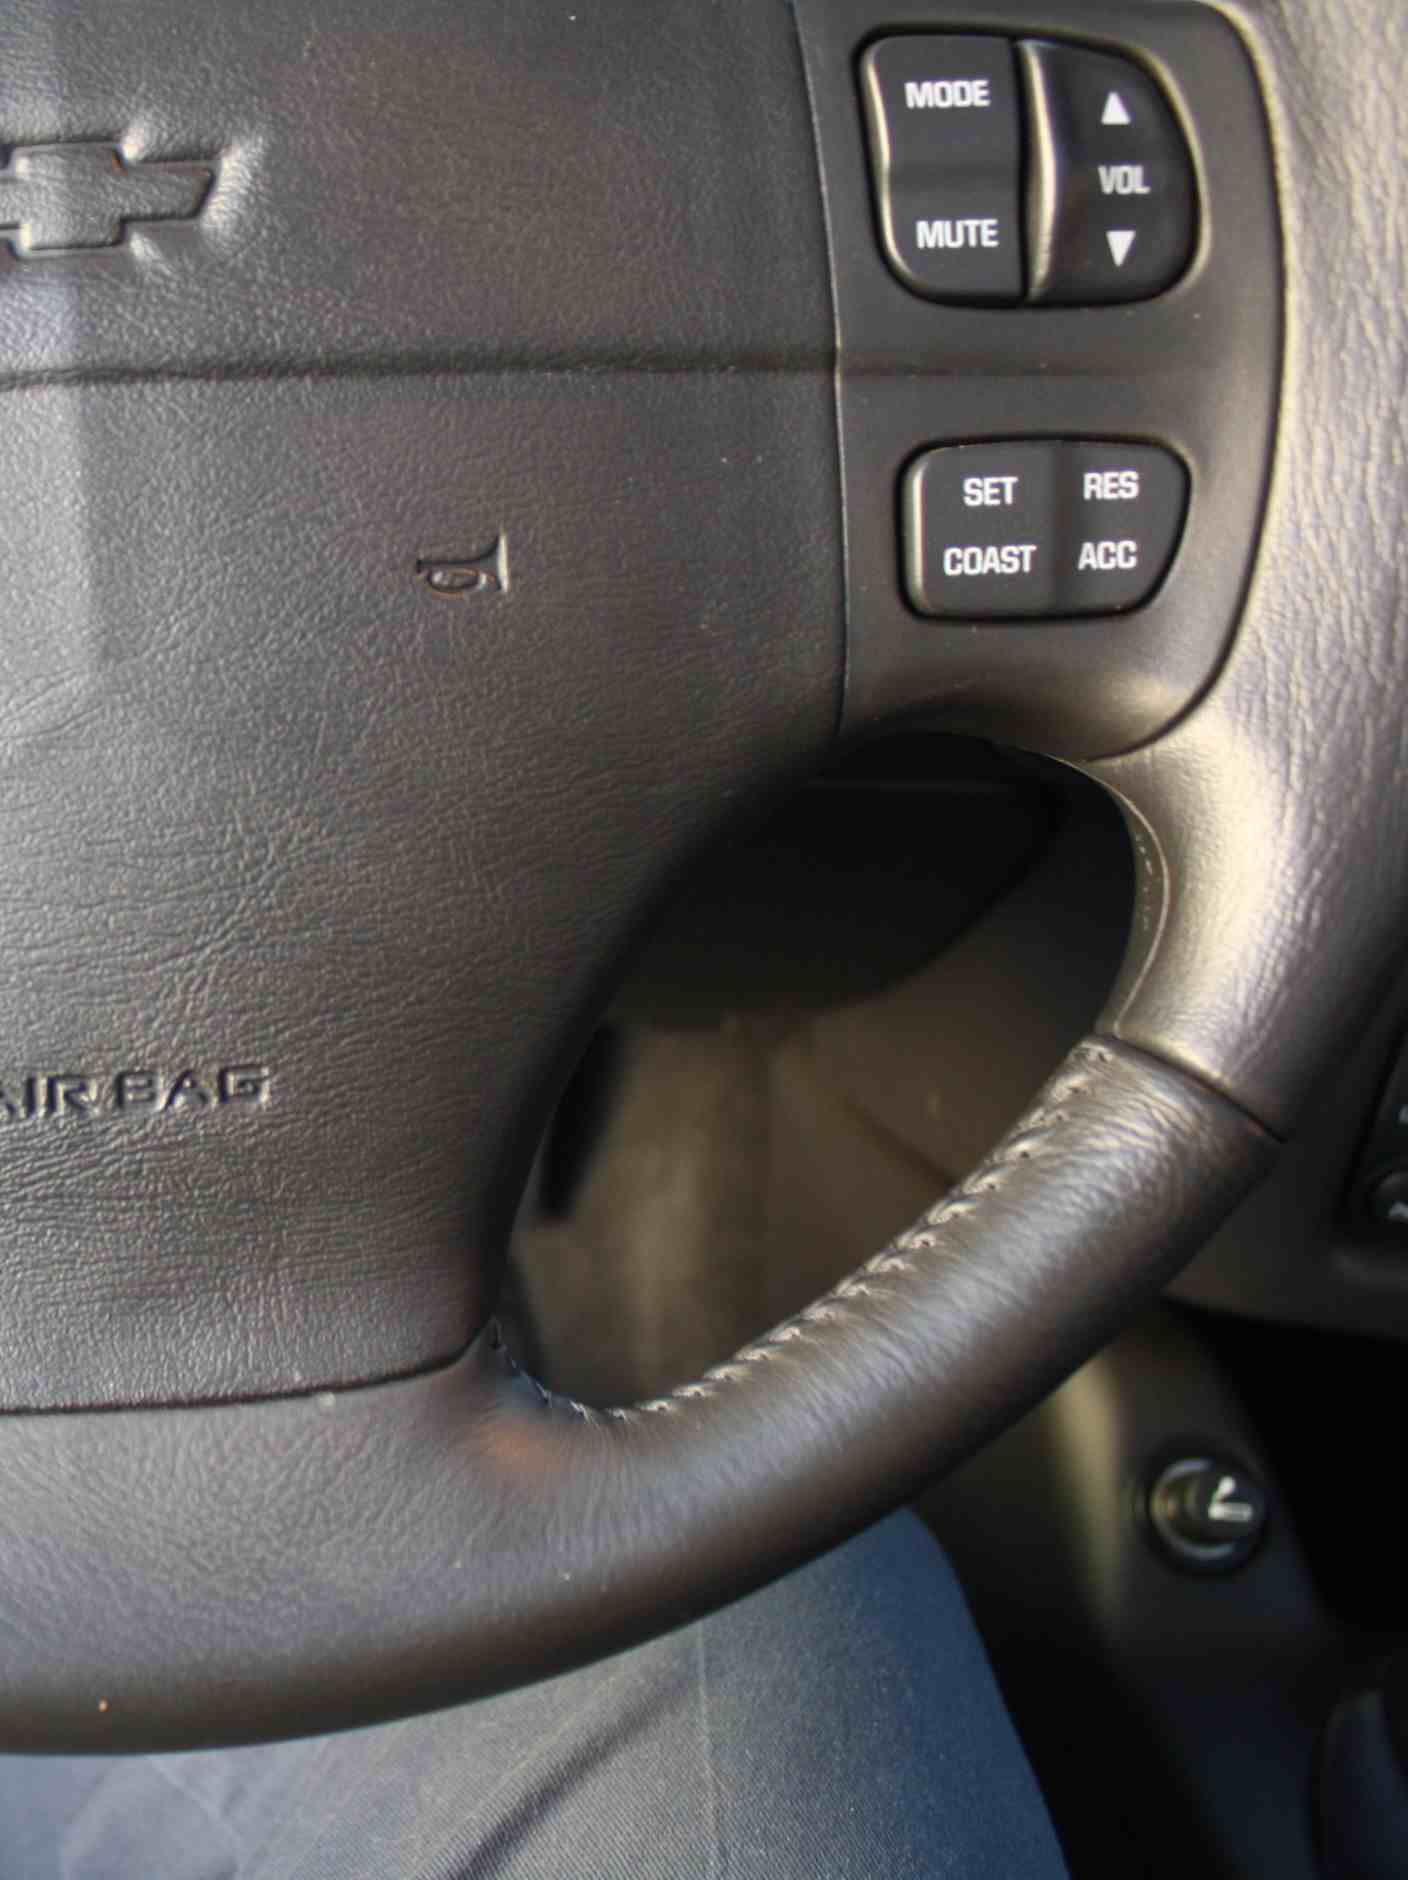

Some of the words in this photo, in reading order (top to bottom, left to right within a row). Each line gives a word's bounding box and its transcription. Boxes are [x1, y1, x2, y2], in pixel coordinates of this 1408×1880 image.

[905, 80, 989, 108] MODE
[1098, 165, 1150, 194] VOL
[917, 219, 998, 248] MUTE
[963, 476, 1017, 506] SET
[1084, 471, 1139, 500] RES
[944, 545, 1036, 576] COAST
[1078, 540, 1137, 570] ACC
